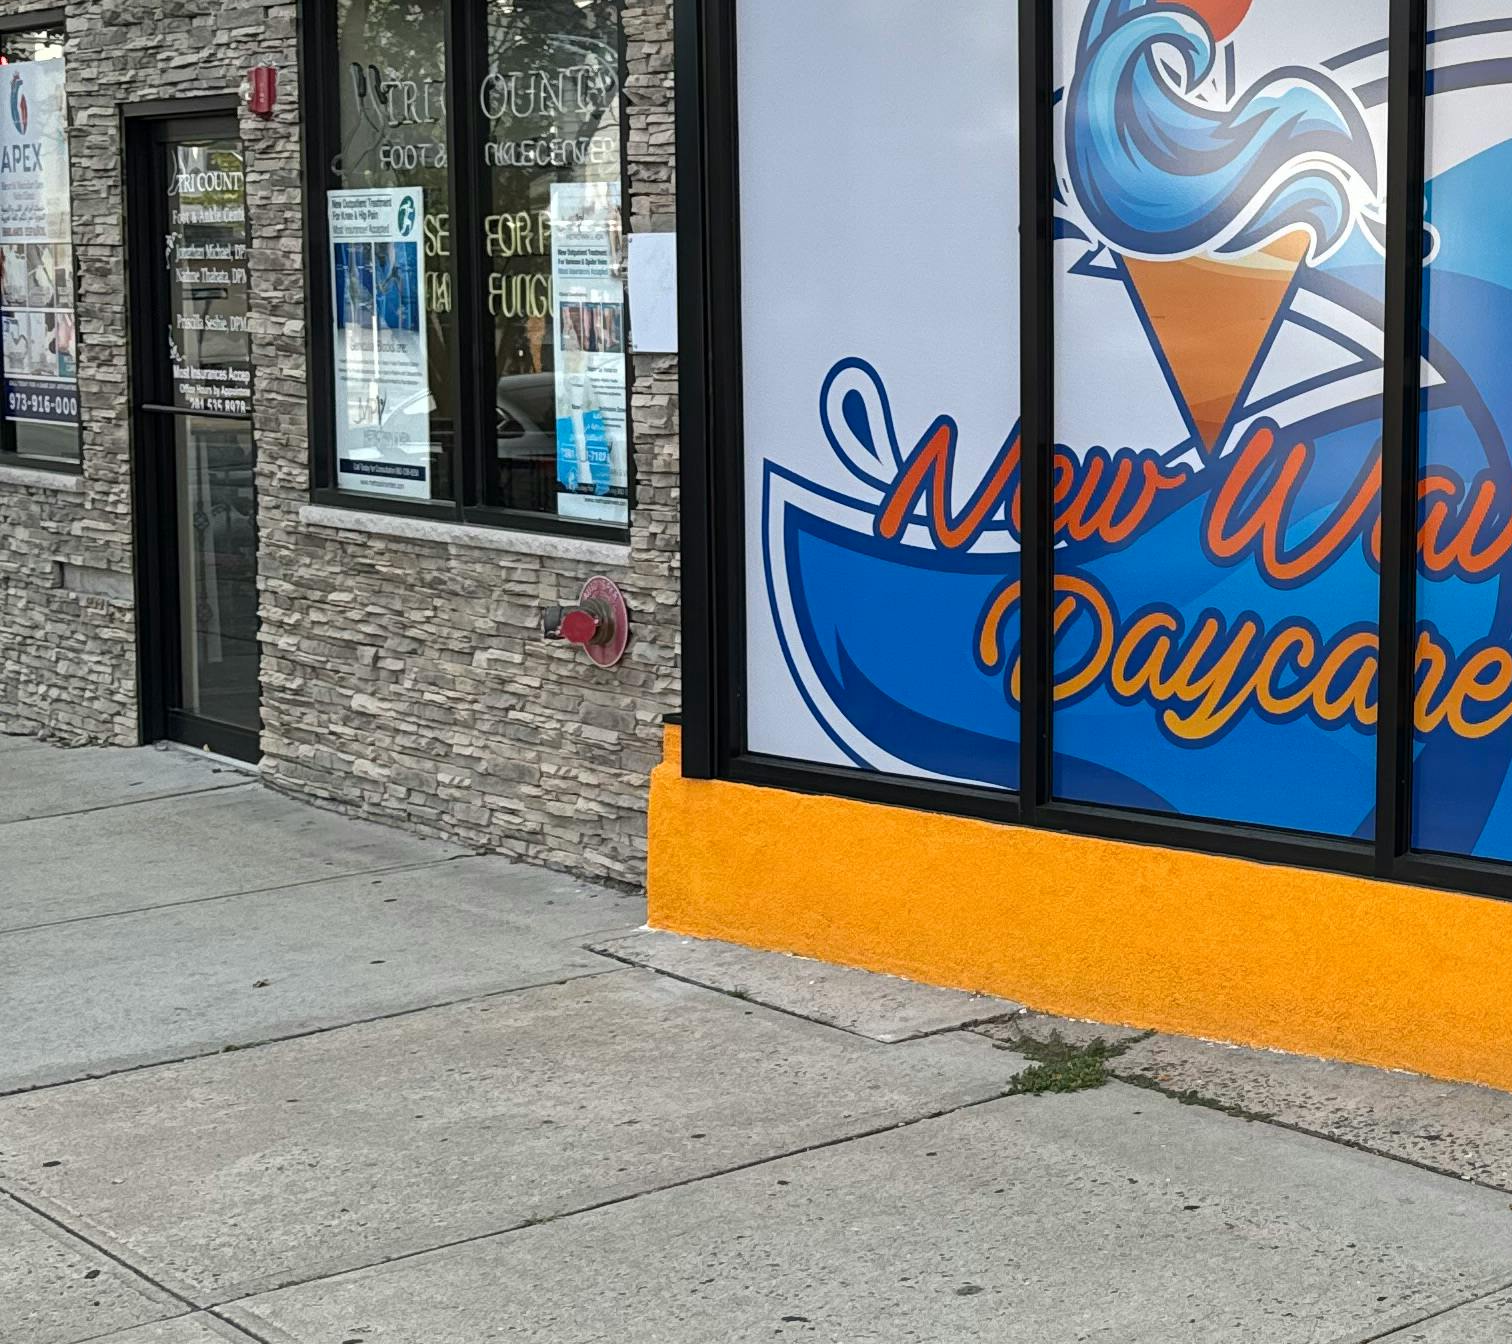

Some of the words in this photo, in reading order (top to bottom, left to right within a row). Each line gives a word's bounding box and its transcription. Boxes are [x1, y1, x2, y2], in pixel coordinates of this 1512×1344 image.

[1, 143, 42, 174] APEX
[379, 143, 433, 169] FOOT
[176, 173, 195, 192] TRI
[484, 211, 533, 257] FOR
[173, 364, 190, 379] Most
[875, 419, 1190, 551] New
